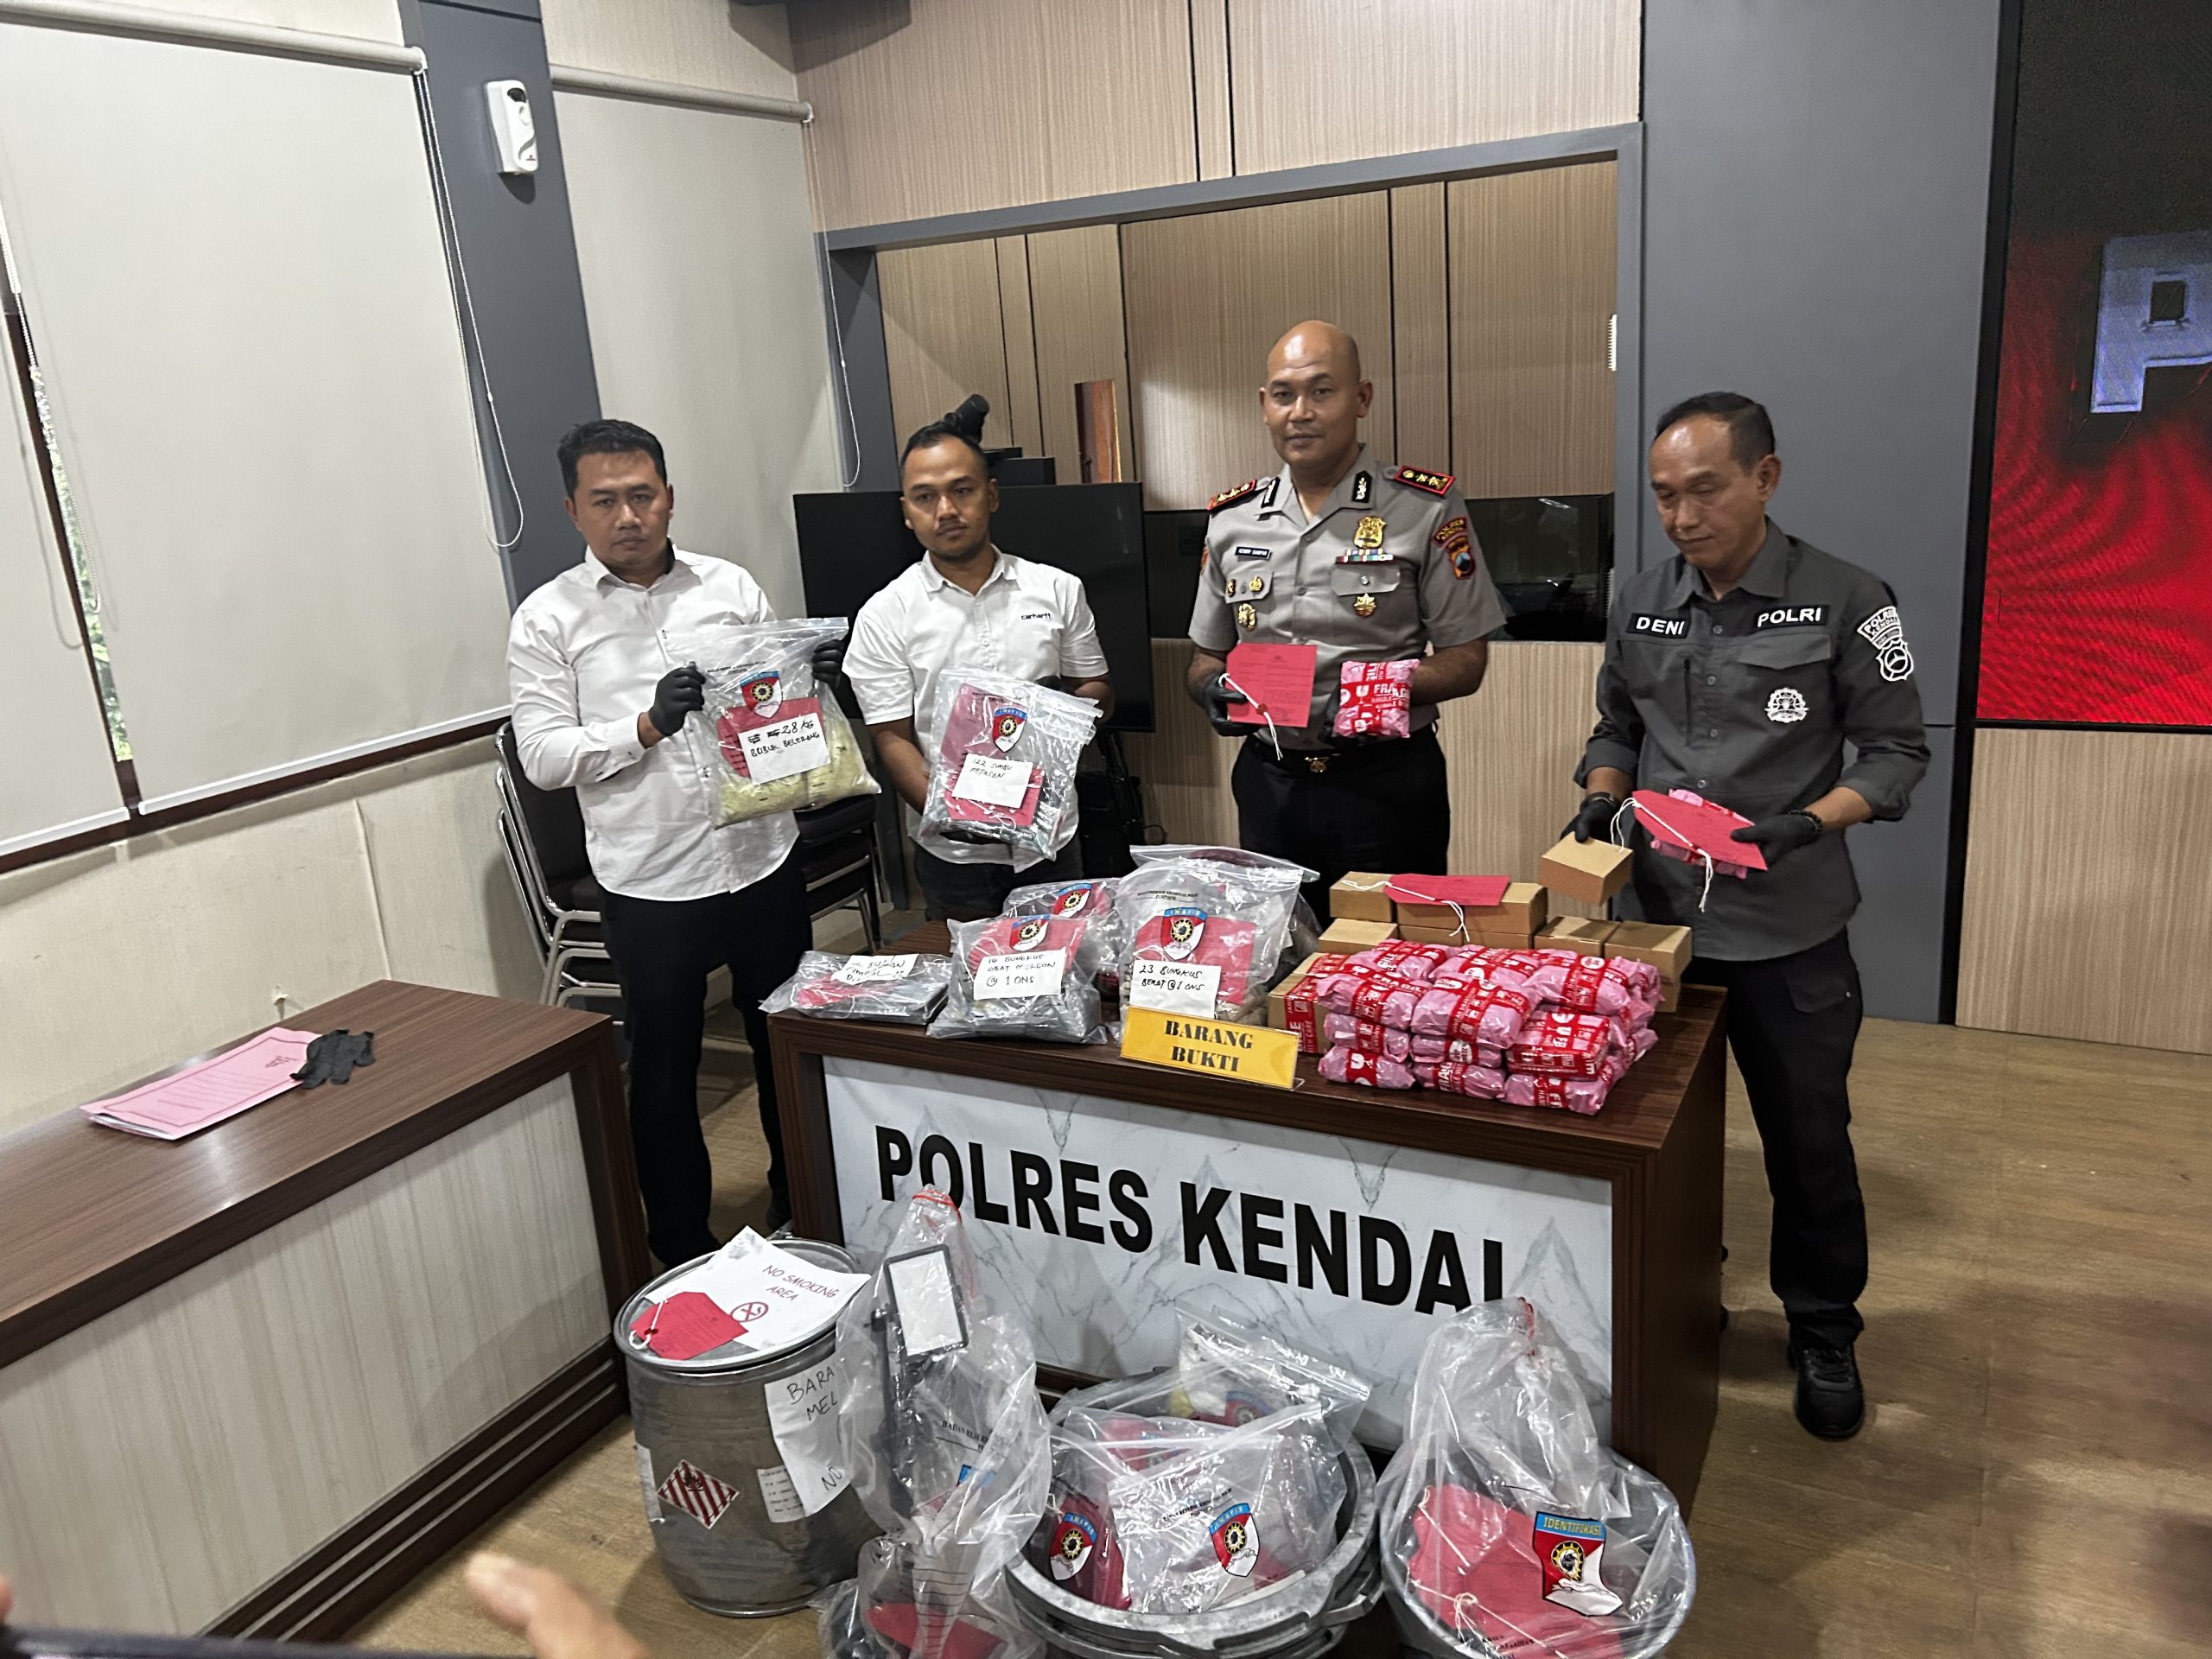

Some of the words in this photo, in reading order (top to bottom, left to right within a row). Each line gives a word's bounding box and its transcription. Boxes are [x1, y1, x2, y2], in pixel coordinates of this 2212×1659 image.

[1636, 616, 1685, 636] DENI
[1757, 607, 1821, 627] POLRI
[800, 720, 814, 730] KG
[1004, 954, 1044, 963] BUNGKUS
[1139, 964, 1154, 974] 23
[1160, 966, 1203, 979] BUNGKUS
[1141, 978, 1166, 989] BERAT
[1164, 1020, 1254, 1050] BARANG
[1171, 1046, 1240, 1072] BUKTI
[874, 1124, 1153, 1254] POLRES
[762, 1264, 785, 1277] NO
[782, 1274, 840, 1298] SMOKING
[766, 1286, 799, 1301] AREA
